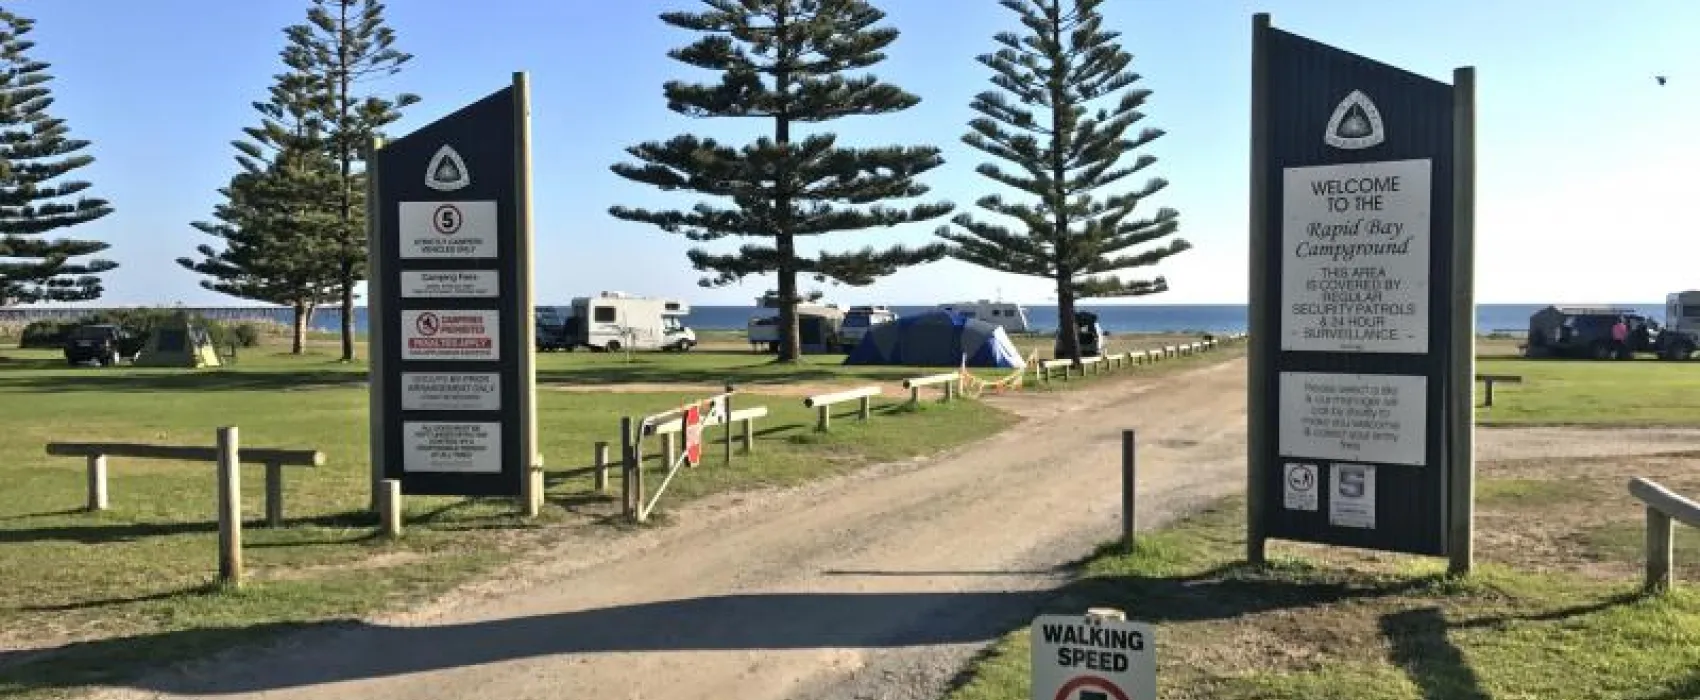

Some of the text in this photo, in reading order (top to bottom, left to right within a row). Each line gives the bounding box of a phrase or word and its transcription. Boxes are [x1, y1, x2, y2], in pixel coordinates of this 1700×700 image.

[1311, 176, 1401, 195] WELCOME
[1328, 195, 1384, 213] TO THE
[442, 212, 454, 228] 5
[1307, 218, 1404, 240] Rapid Bay
[1295, 235, 1415, 261] Campground
[421, 274, 457, 282] Camping
[1321, 267, 1386, 278] THIS AREA
[1307, 279, 1401, 291] IS COVERED BY
[1323, 292, 1382, 302] REGULAR
[1292, 303, 1416, 315] SECURITY PATROLS
[1349, 316, 1385, 327] HOUR
[1043, 624, 1144, 650] WALKING
[1058, 648, 1128, 672] SPEED
